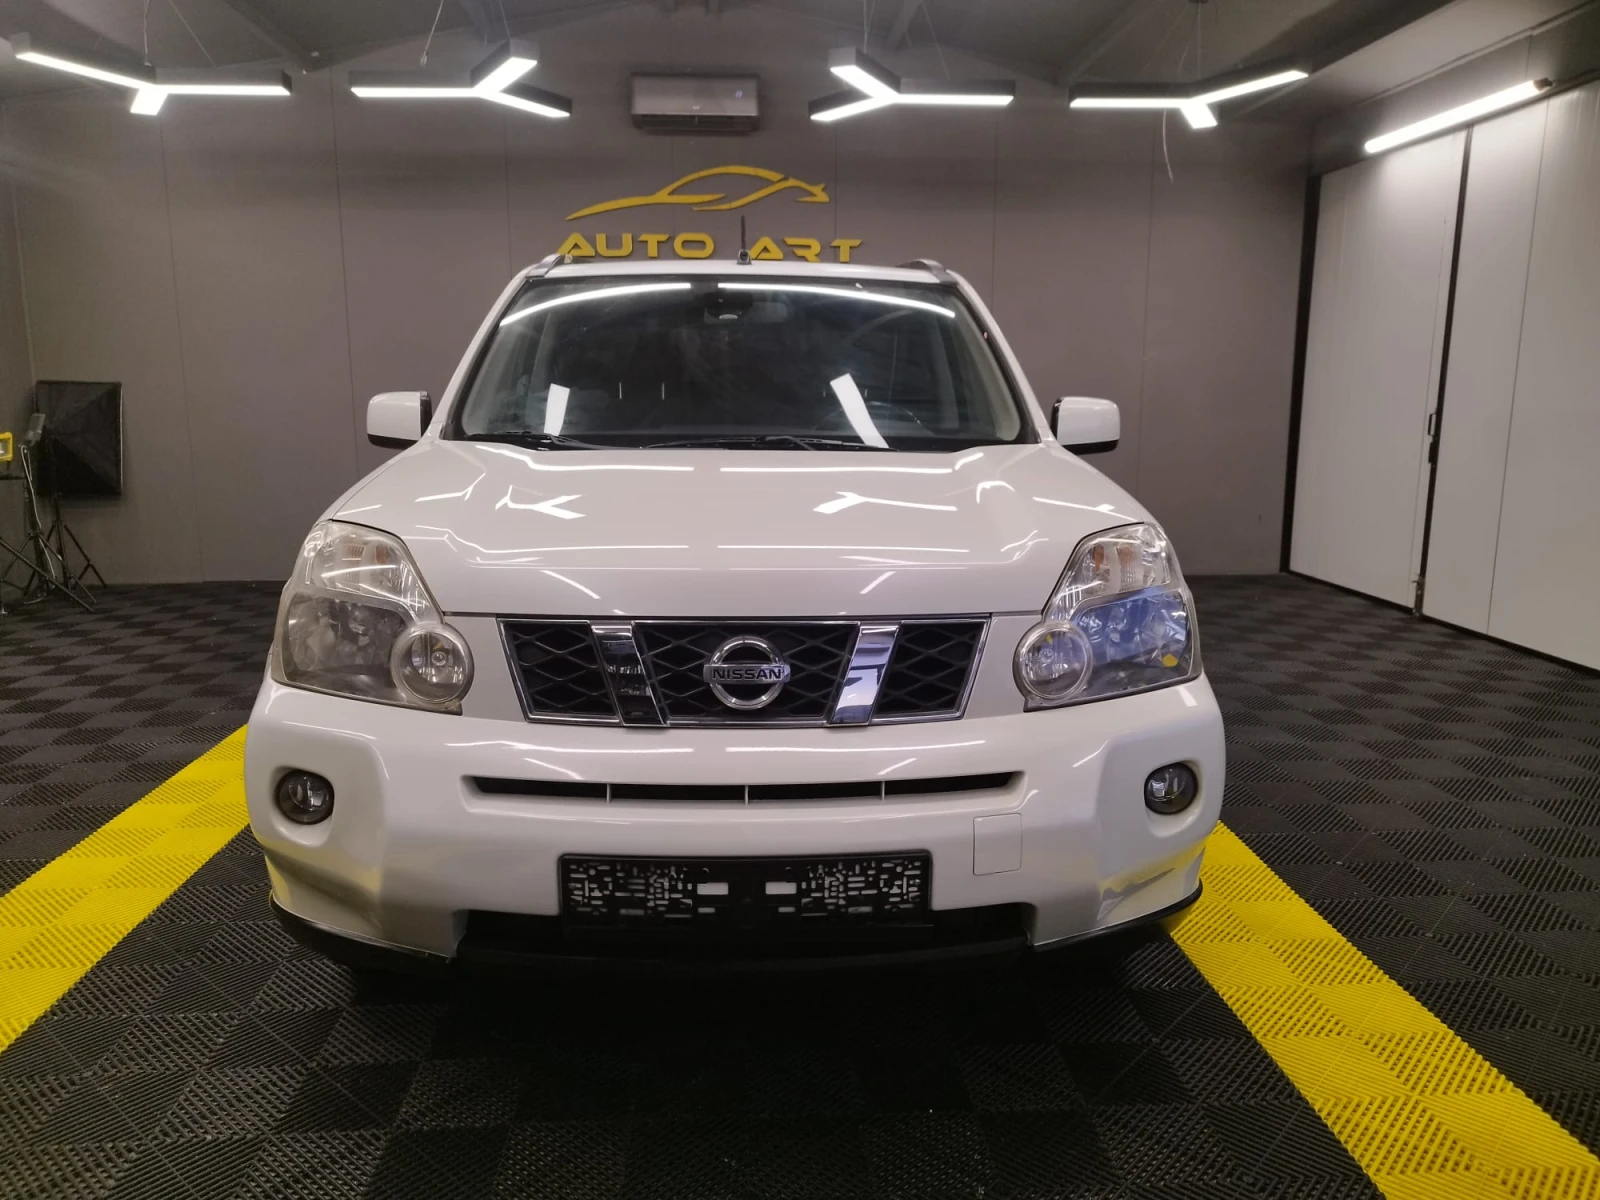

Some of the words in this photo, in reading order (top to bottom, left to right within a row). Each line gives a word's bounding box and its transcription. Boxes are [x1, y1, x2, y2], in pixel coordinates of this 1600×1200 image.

[556, 232, 715, 258] AUTO
[749, 236, 862, 263] ART
[712, 668, 781, 680] NISSAN
